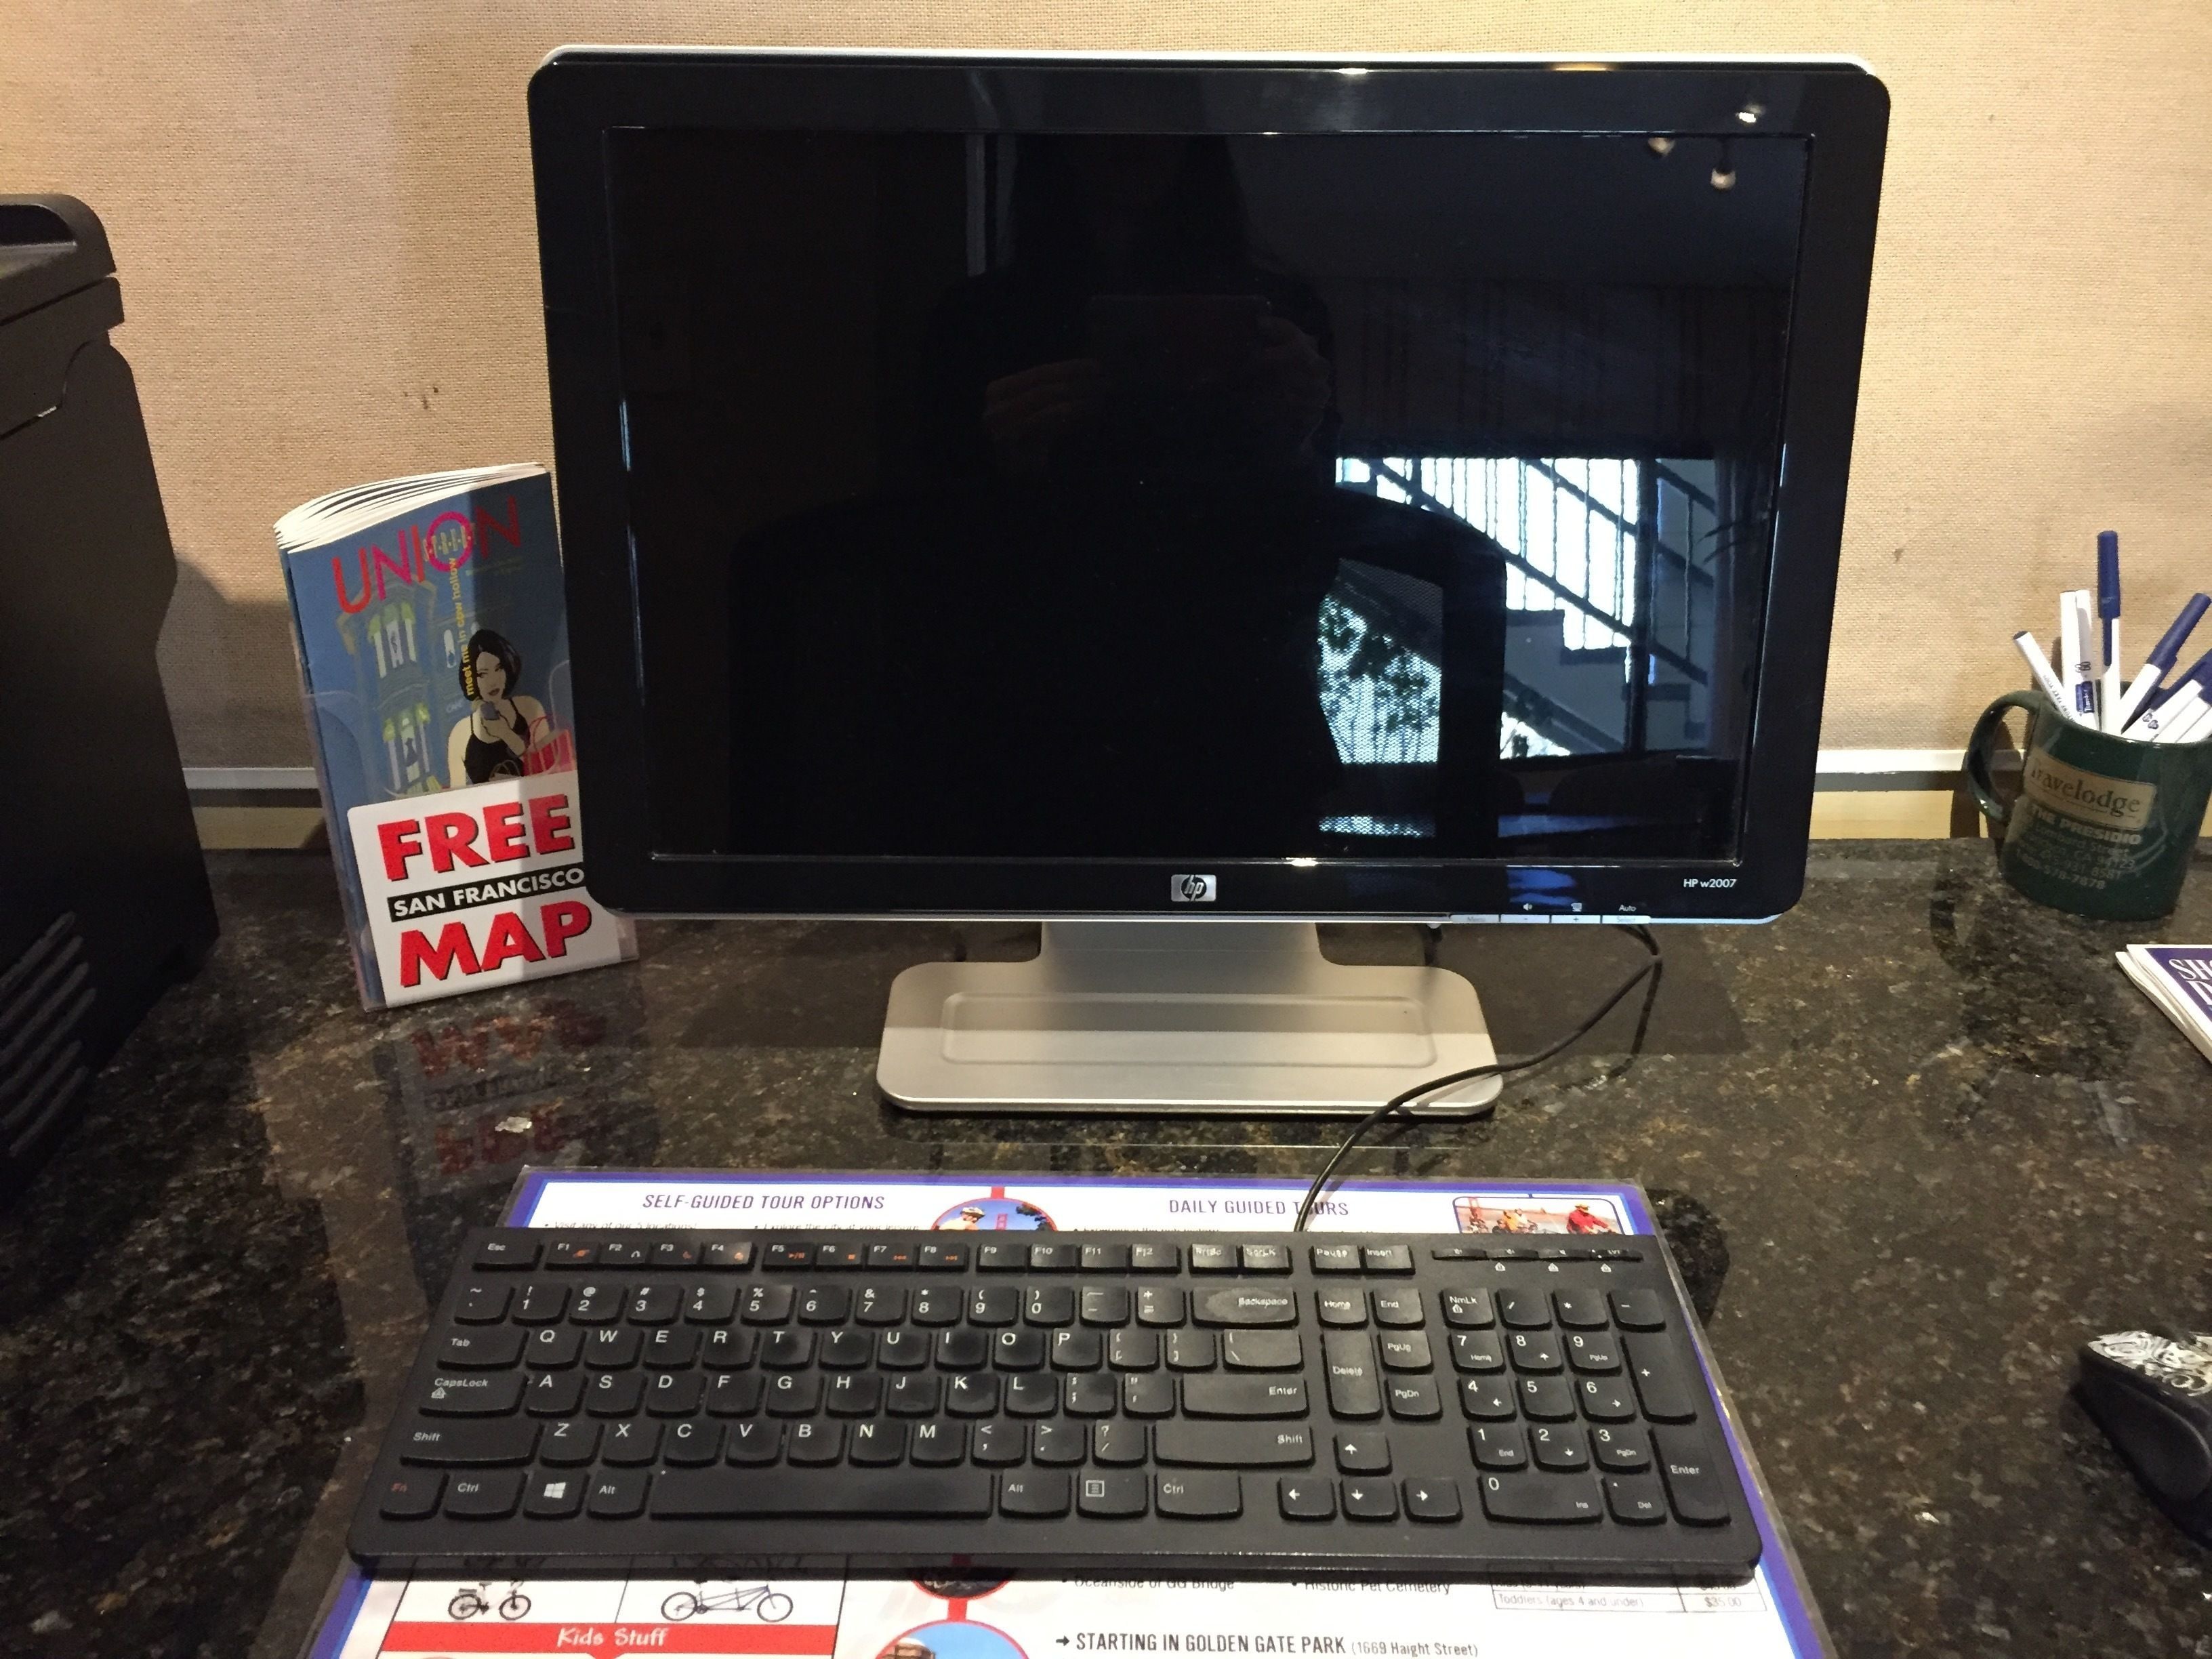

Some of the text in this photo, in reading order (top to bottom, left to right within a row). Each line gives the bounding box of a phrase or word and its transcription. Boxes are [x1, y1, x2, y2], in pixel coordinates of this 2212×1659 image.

[331, 495, 521, 613] UNION
[377, 794, 575, 882] FREE
[1683, 878, 1738, 888] HP w2007
[394, 867, 584, 916] SAN FRANCISCO
[1618, 904, 1637, 912] Auto
[400, 900, 592, 988] MAP
[642, 1194, 885, 1210] SELF-GUIDED TOUR OPTIONS
[1169, 1200, 1218, 1214] DAILY
[1225, 1200, 1286, 1214] GUIDED
[487, 1243, 506, 1251] Esc
[660, 1244, 674, 1252] F3
[771, 1244, 785, 1252] F5
[823, 1245, 836, 1253] F6
[924, 1246, 937, 1254] F8
[1034, 1247, 1052, 1255] F10
[1136, 1247, 1153, 1256] F12
[523, 1299, 529, 1310] 1
[577, 1299, 590, 1311] 2
[636, 1300, 647, 1311] 3
[693, 1300, 703, 1311] 4
[750, 1300, 760, 1311] 5
[806, 1300, 817, 1311] 6
[863, 1301, 874, 1313] 7
[918, 1302, 929, 1313] 8
[975, 1302, 985, 1313] 9
[1031, 1303, 1042, 1314] 0
[1238, 1296, 1288, 1309] Backspace
[1380, 1300, 1399, 1309] End
[452, 1338, 470, 1347] Tab
[539, 1330, 556, 1343] Q
[600, 1330, 618, 1343] W
[655, 1330, 669, 1343] E
[713, 1330, 727, 1343] R
[773, 1330, 785, 1343] T
[831, 1331, 844, 1343] Y
[886, 1332, 900, 1345] U
[945, 1332, 950, 1344] I
[1002, 1332, 1016, 1345] O
[1058, 1332, 1071, 1346] P
[1457, 1335, 1467, 1346] 7
[1515, 1335, 1527, 1347] 8
[1573, 1336, 1584, 1347] 9
[434, 1378, 488, 1388] CapsLock
[539, 1374, 552, 1388] A
[598, 1374, 613, 1389] S
[658, 1374, 673, 1389] D
[717, 1375, 731, 1388] F
[777, 1375, 792, 1389] G
[836, 1376, 851, 1389] H
[895, 1376, 906, 1389] J
[954, 1376, 968, 1389] K
[1012, 1376, 1023, 1390] L
[1468, 1380, 1478, 1392] 4
[1527, 1380, 1538, 1393] 5
[1586, 1381, 1597, 1393] 6
[1269, 1387, 1297, 1395] Enter
[1395, 1389, 1420, 1398] PgDn
[554, 1422, 570, 1437] Z
[615, 1423, 630, 1437] X
[677, 1423, 692, 1438] C
[739, 1423, 753, 1437] V
[798, 1424, 812, 1437] B
[859, 1424, 874, 1438] N
[920, 1425, 936, 1438] M
[1478, 1428, 1486, 1441] 1
[1538, 1428, 1550, 1441] 2
[1599, 1429, 1611, 1441] 3
[413, 1432, 441, 1441] Shift
[1277, 1435, 1303, 1443] Shift
[1671, 1465, 1700, 1475] Enter
[457, 1483, 478, 1492] Ctrl
[599, 1485, 615, 1494] Alt
[1008, 1484, 1024, 1494] Alt
[1163, 1483, 1185, 1494] Ctrl
[1488, 1477, 1500, 1491] 0
[1588, 1597, 1606, 1606] and
[556, 1626, 668, 1647] Kids Stuff
[1076, 1633, 1478, 1658] STARTING IN GOLDEN GATE PARK (1669 Haight Street)
